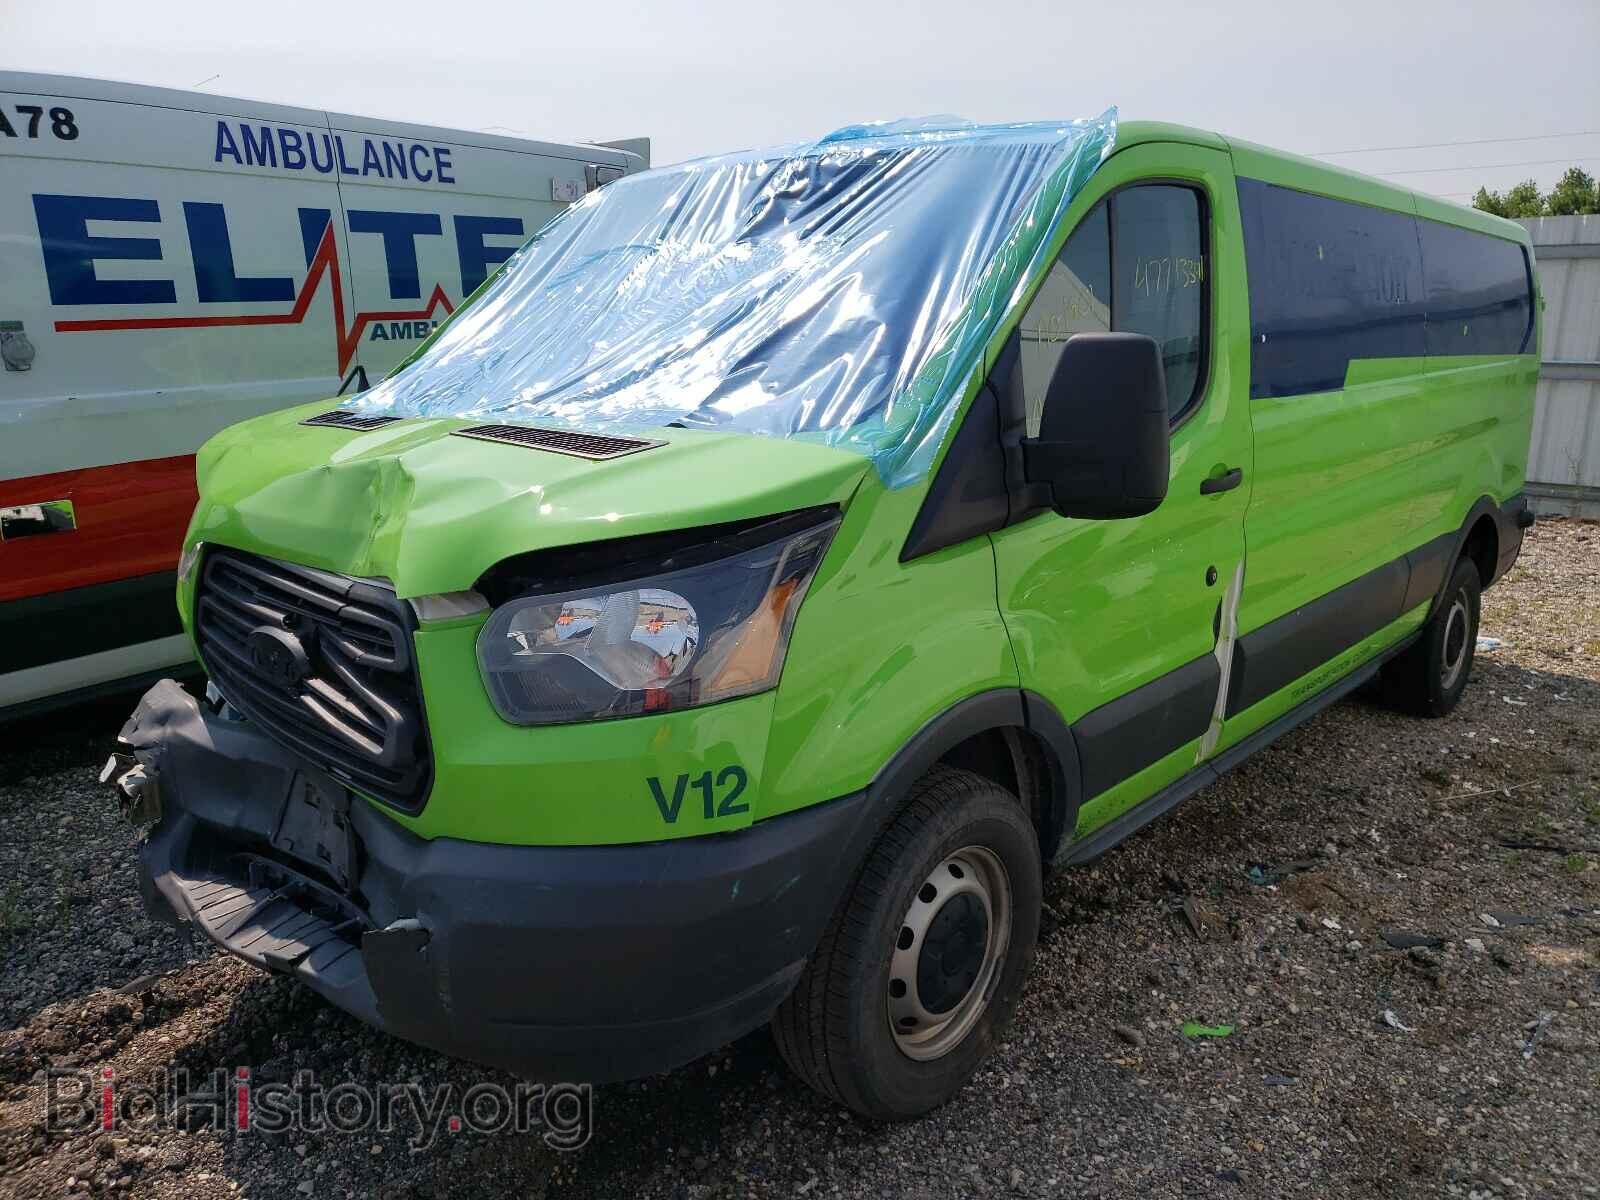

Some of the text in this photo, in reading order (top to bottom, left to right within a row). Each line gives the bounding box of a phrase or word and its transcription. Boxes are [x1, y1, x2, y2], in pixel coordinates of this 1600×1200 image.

[215, 121, 455, 184] AMBULANCE
[369, 321, 437, 341] AMB
[646, 765, 749, 823] V12
